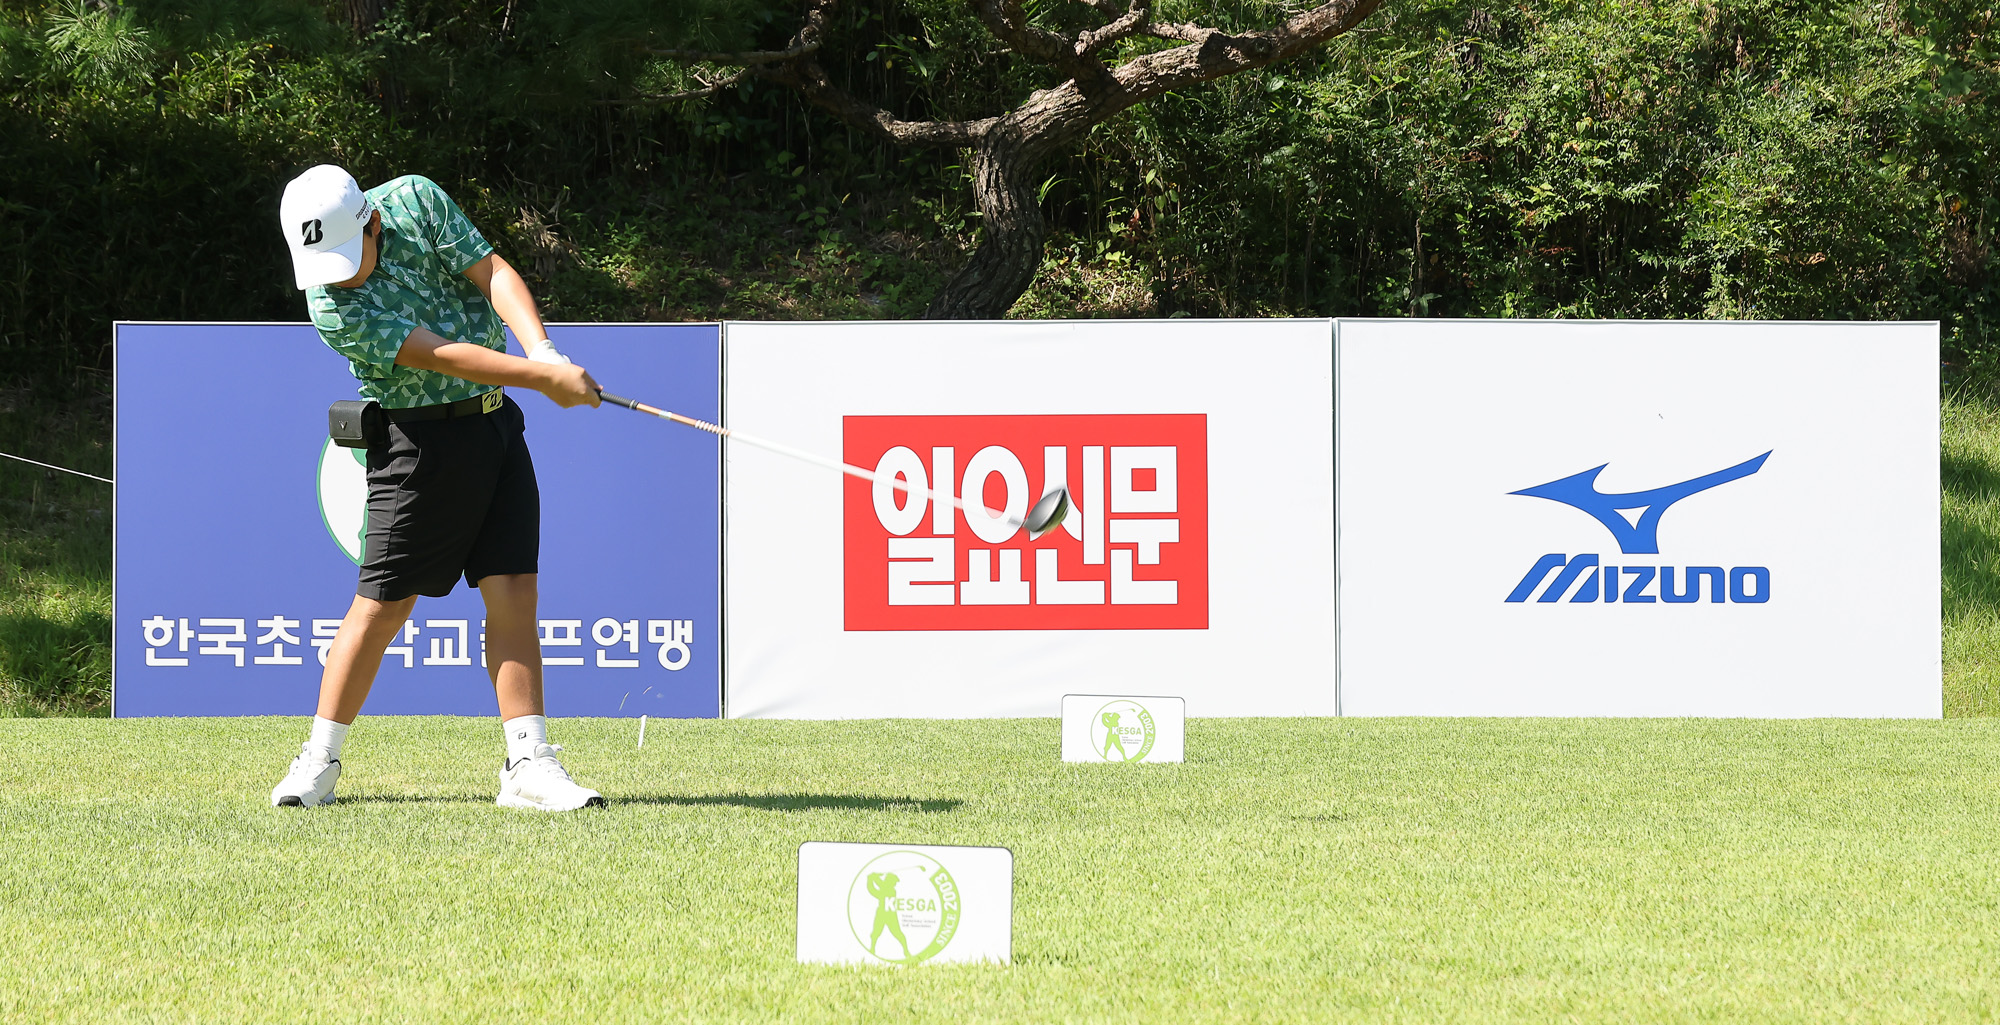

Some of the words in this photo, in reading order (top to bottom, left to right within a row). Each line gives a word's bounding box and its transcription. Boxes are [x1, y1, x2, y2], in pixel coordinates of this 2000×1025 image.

[872, 445, 1180, 606] 일요신문
[1111, 726, 1142, 735] KESGA
[1140, 712, 1154, 734] 2003
[1141, 735, 1154, 754] SINCE
[934, 872, 958, 912] 2003
[884, 896, 936, 913] KESGA
[935, 913, 957, 947] SINCE
